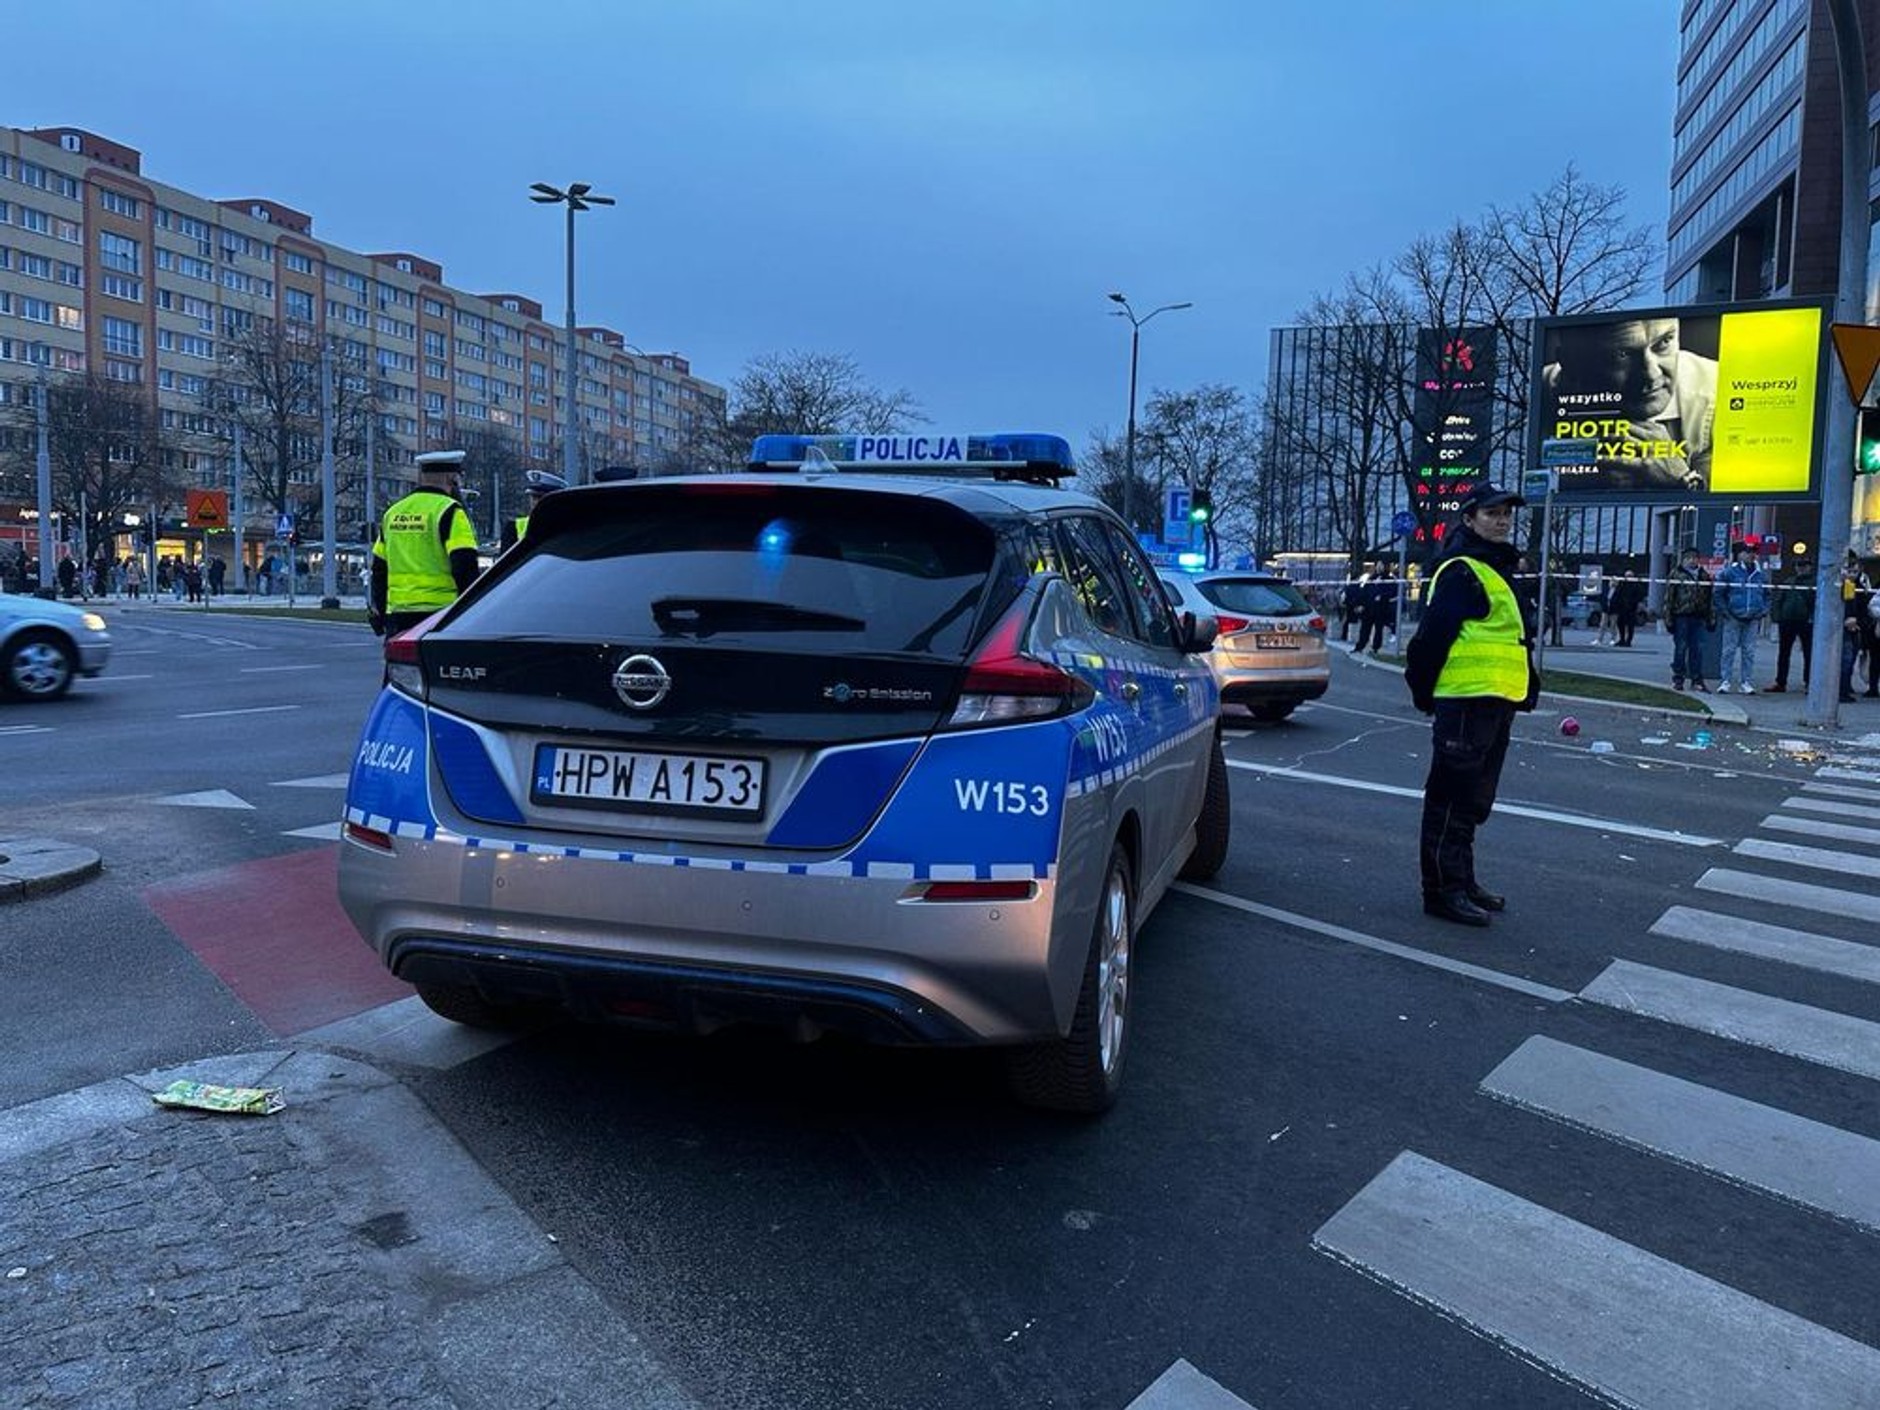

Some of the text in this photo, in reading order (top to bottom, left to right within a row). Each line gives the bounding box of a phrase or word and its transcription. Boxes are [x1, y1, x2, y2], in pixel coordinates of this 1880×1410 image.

[1731, 376, 1798, 391] Wesprzyj
[1558, 391, 1622, 405] wszystko
[1556, 419, 1631, 439] PIOTR
[861, 437, 962, 461] POLICJA
[440, 665, 487, 680] LEAF
[869, 687, 932, 701] Emission
[1085, 713, 1128, 763] W153
[357, 740, 414, 774] POLICJA
[537, 776, 550, 789] PL
[560, 752, 752, 806] HPW A153
[955, 779, 1049, 816] W153
